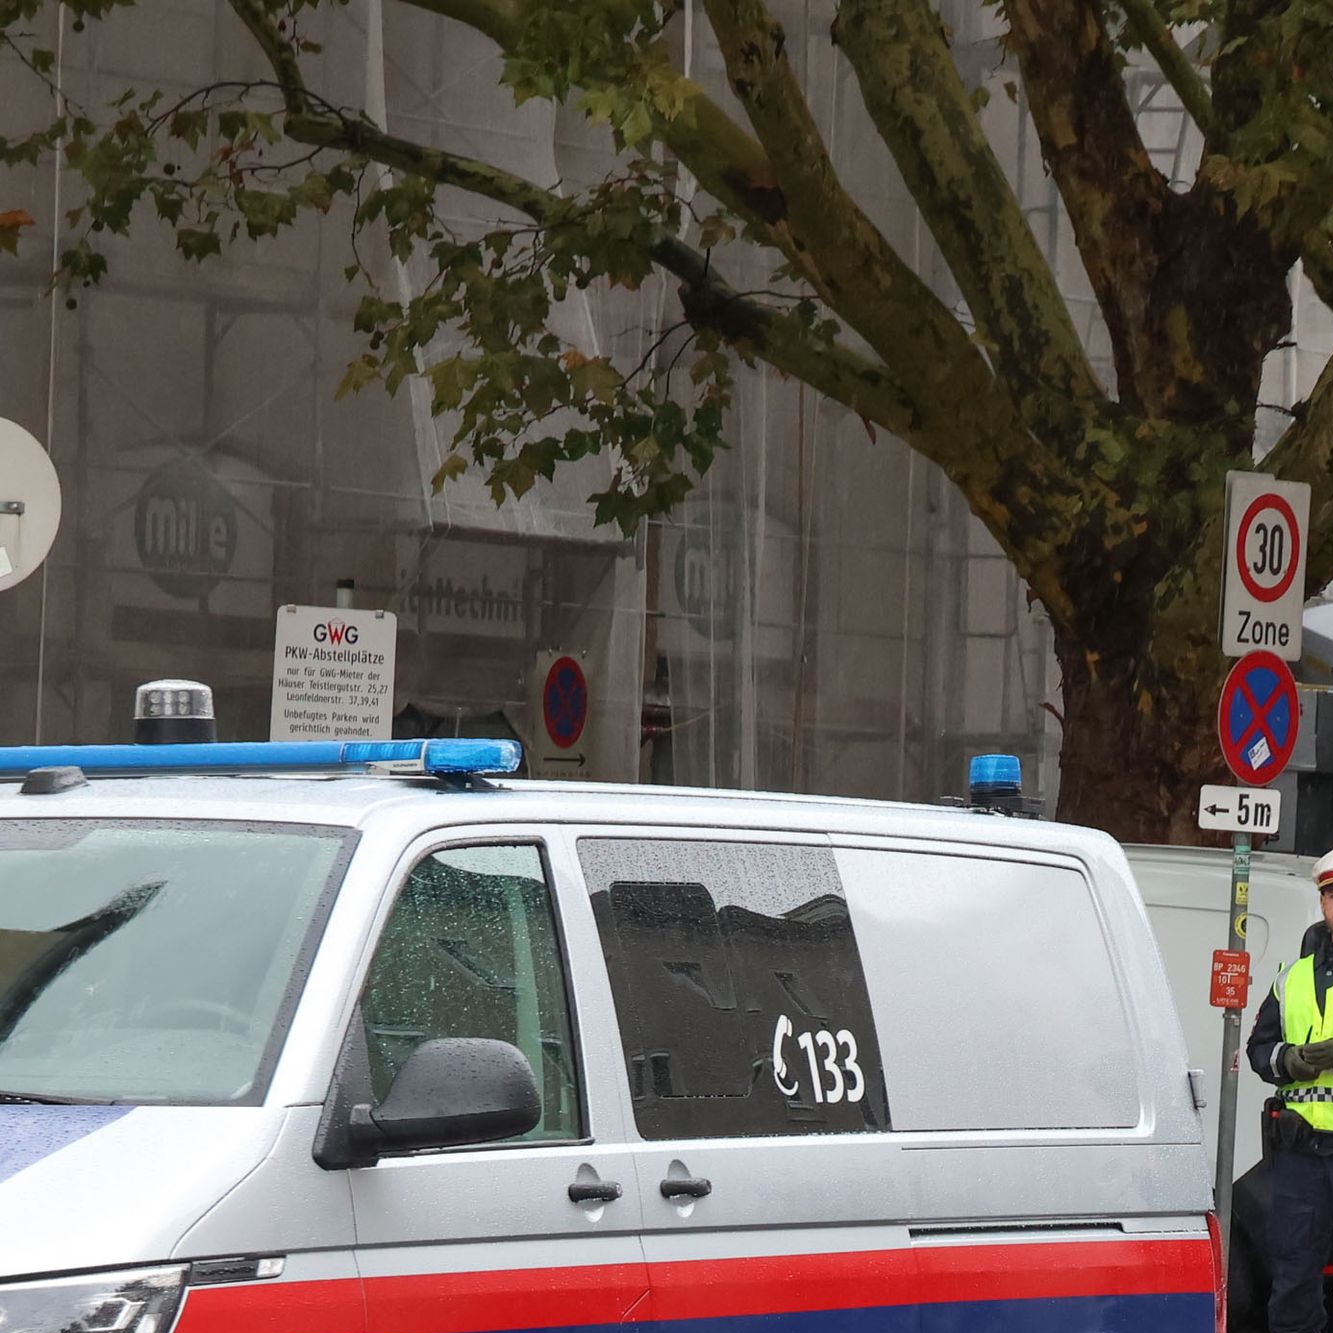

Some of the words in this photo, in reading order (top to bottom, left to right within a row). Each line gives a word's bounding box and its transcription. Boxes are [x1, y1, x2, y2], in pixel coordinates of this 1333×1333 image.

[1253, 523, 1284, 576] 30
[313, 622, 358, 646] GWG
[1236, 610, 1290, 647] Zone
[284, 645, 385, 665] PKW-Abstellplätze
[278, 678, 305, 689] Häuser
[286, 666, 300, 676] nur
[303, 666, 316, 676] für
[319, 667, 364, 680] GWG-Mieter
[367, 671, 381, 681] der
[284, 709, 328, 721] Unbefugtes
[331, 711, 358, 722] Parken
[361, 714, 380, 724] wird
[289, 722, 331, 734] gerichtlich
[797, 1029, 865, 1104] 133
